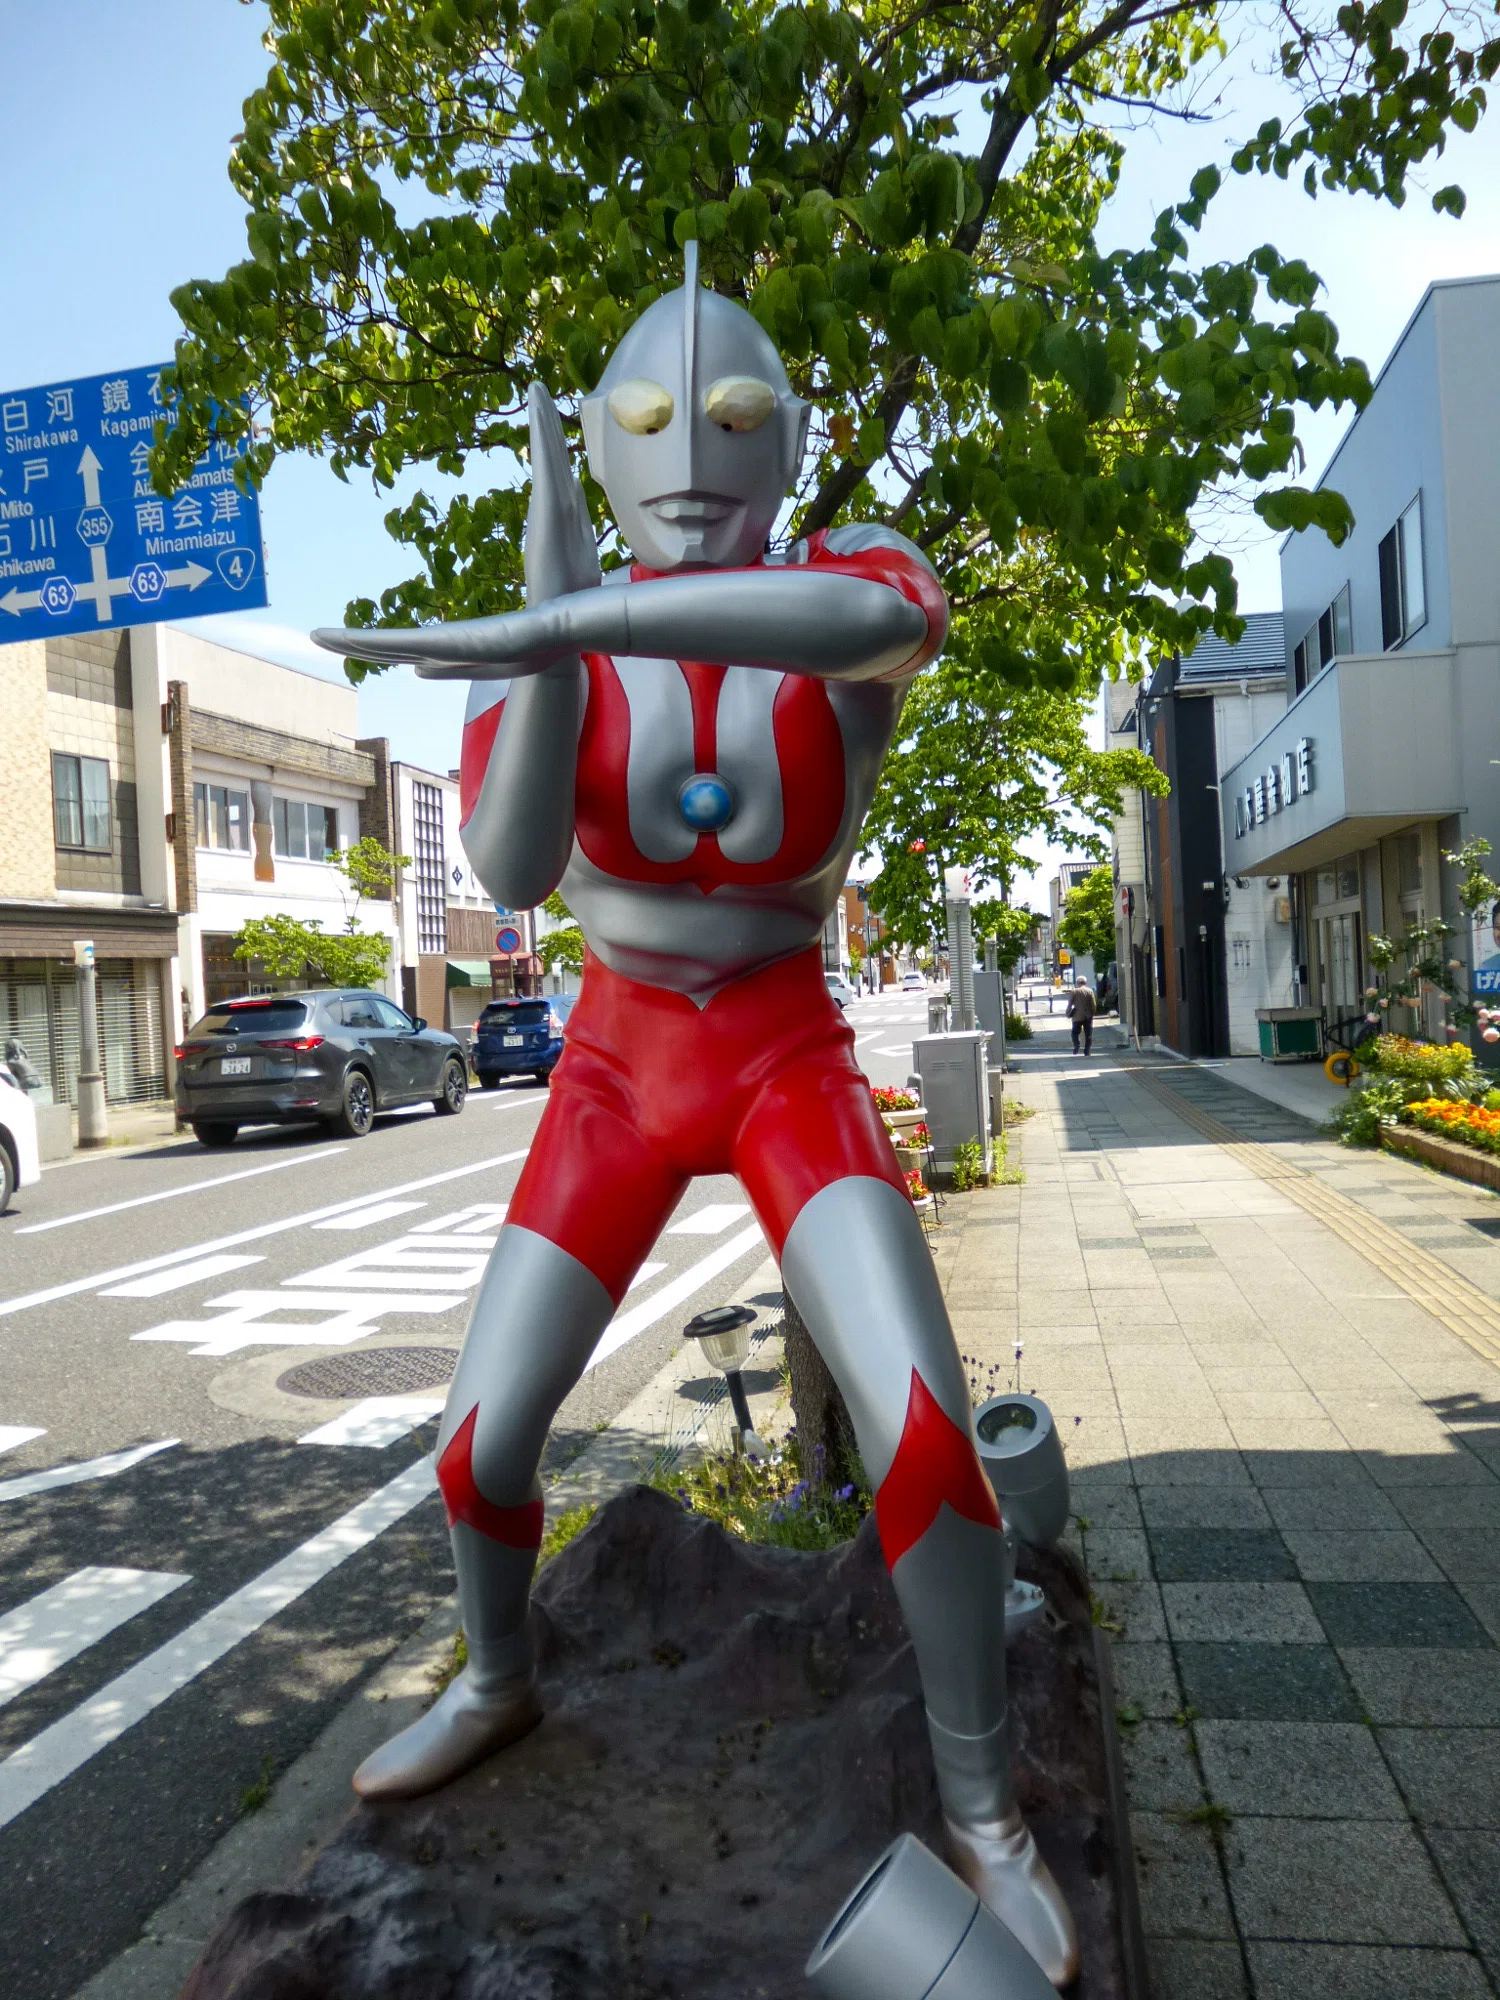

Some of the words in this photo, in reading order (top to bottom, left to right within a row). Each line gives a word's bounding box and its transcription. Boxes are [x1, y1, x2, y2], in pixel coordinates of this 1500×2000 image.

[2, 387, 74, 433] 白河
[5, 426, 78, 455] Shirakawa
[1, 500, 33, 520] Mito
[134, 488, 242, 536] 南会津
[82, 517, 107, 538] 355
[146, 528, 236, 556] Minamiaizu
[229, 556, 243, 579] 4
[137, 571, 158, 593] 63
[48, 586, 69, 606] 63
